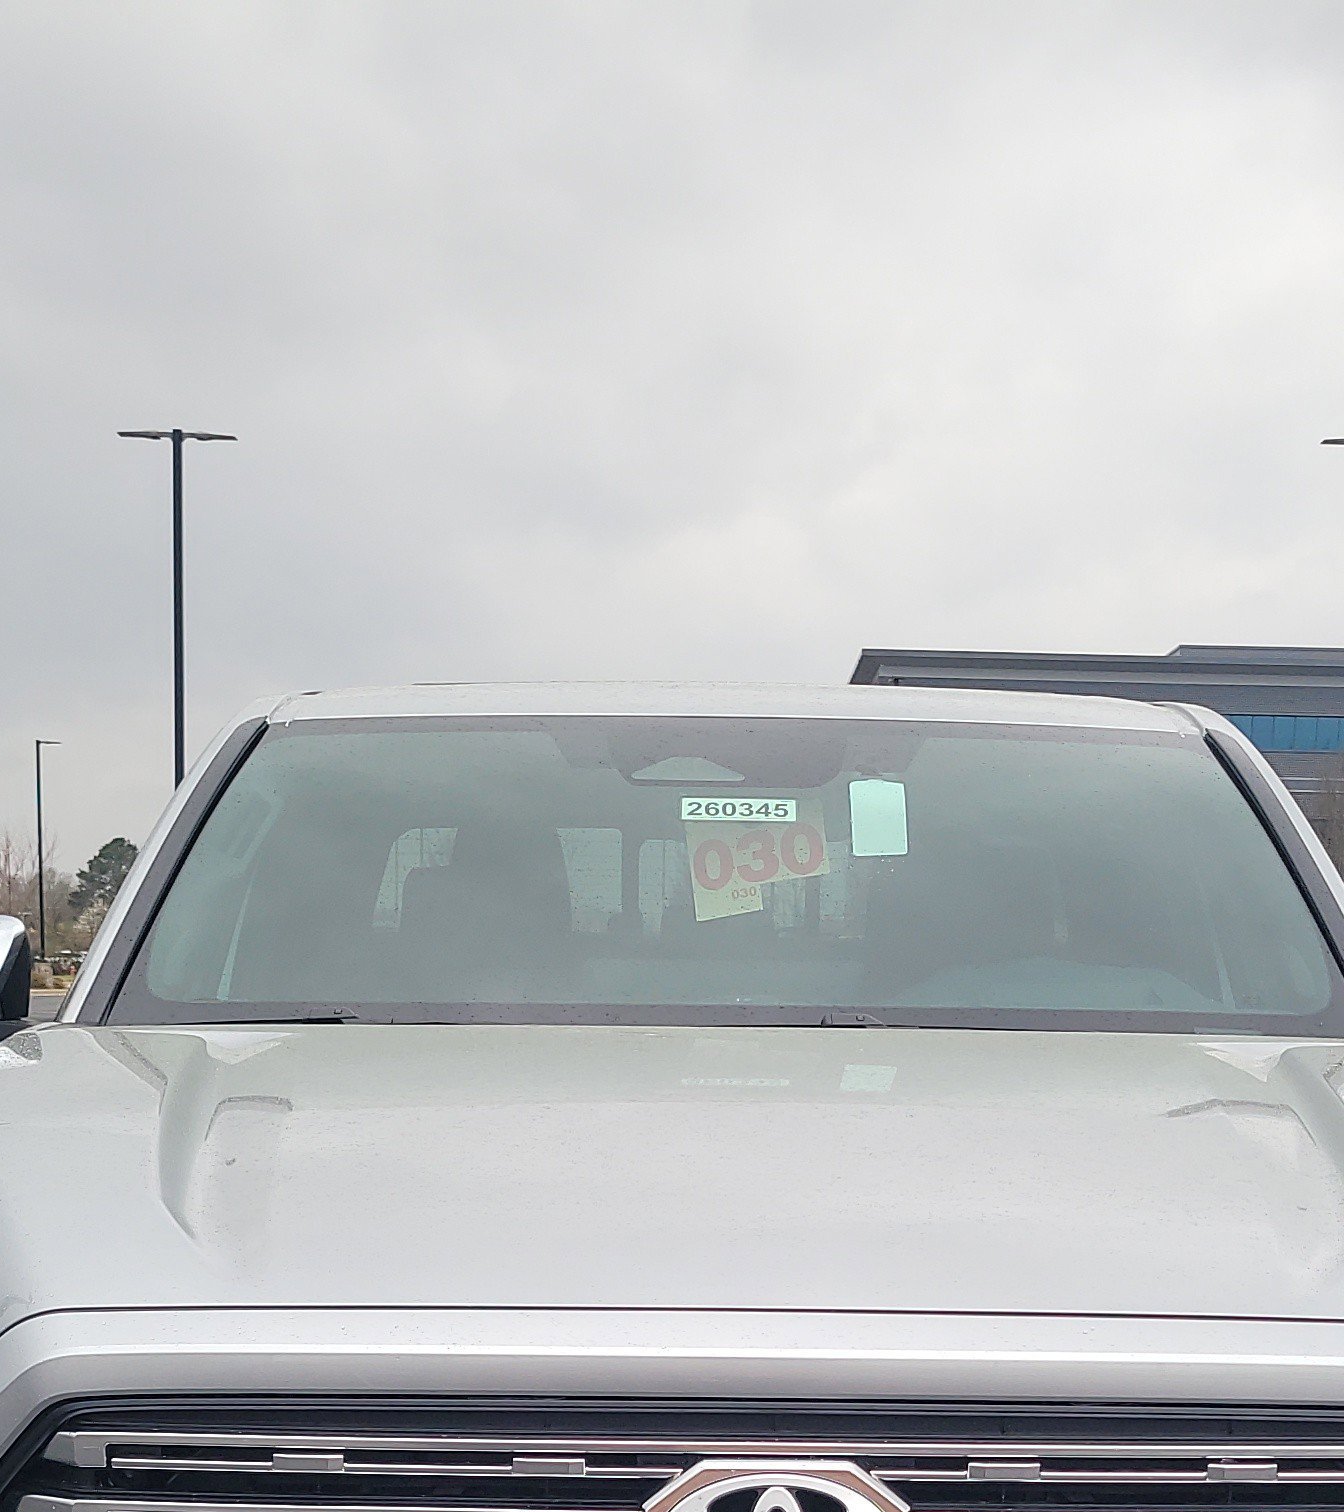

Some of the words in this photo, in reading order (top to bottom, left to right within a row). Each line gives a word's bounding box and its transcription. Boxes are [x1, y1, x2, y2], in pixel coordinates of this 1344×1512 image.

[686, 801, 789, 818] 260345
[693, 822, 824, 891] 030
[731, 886, 757, 899] 030
